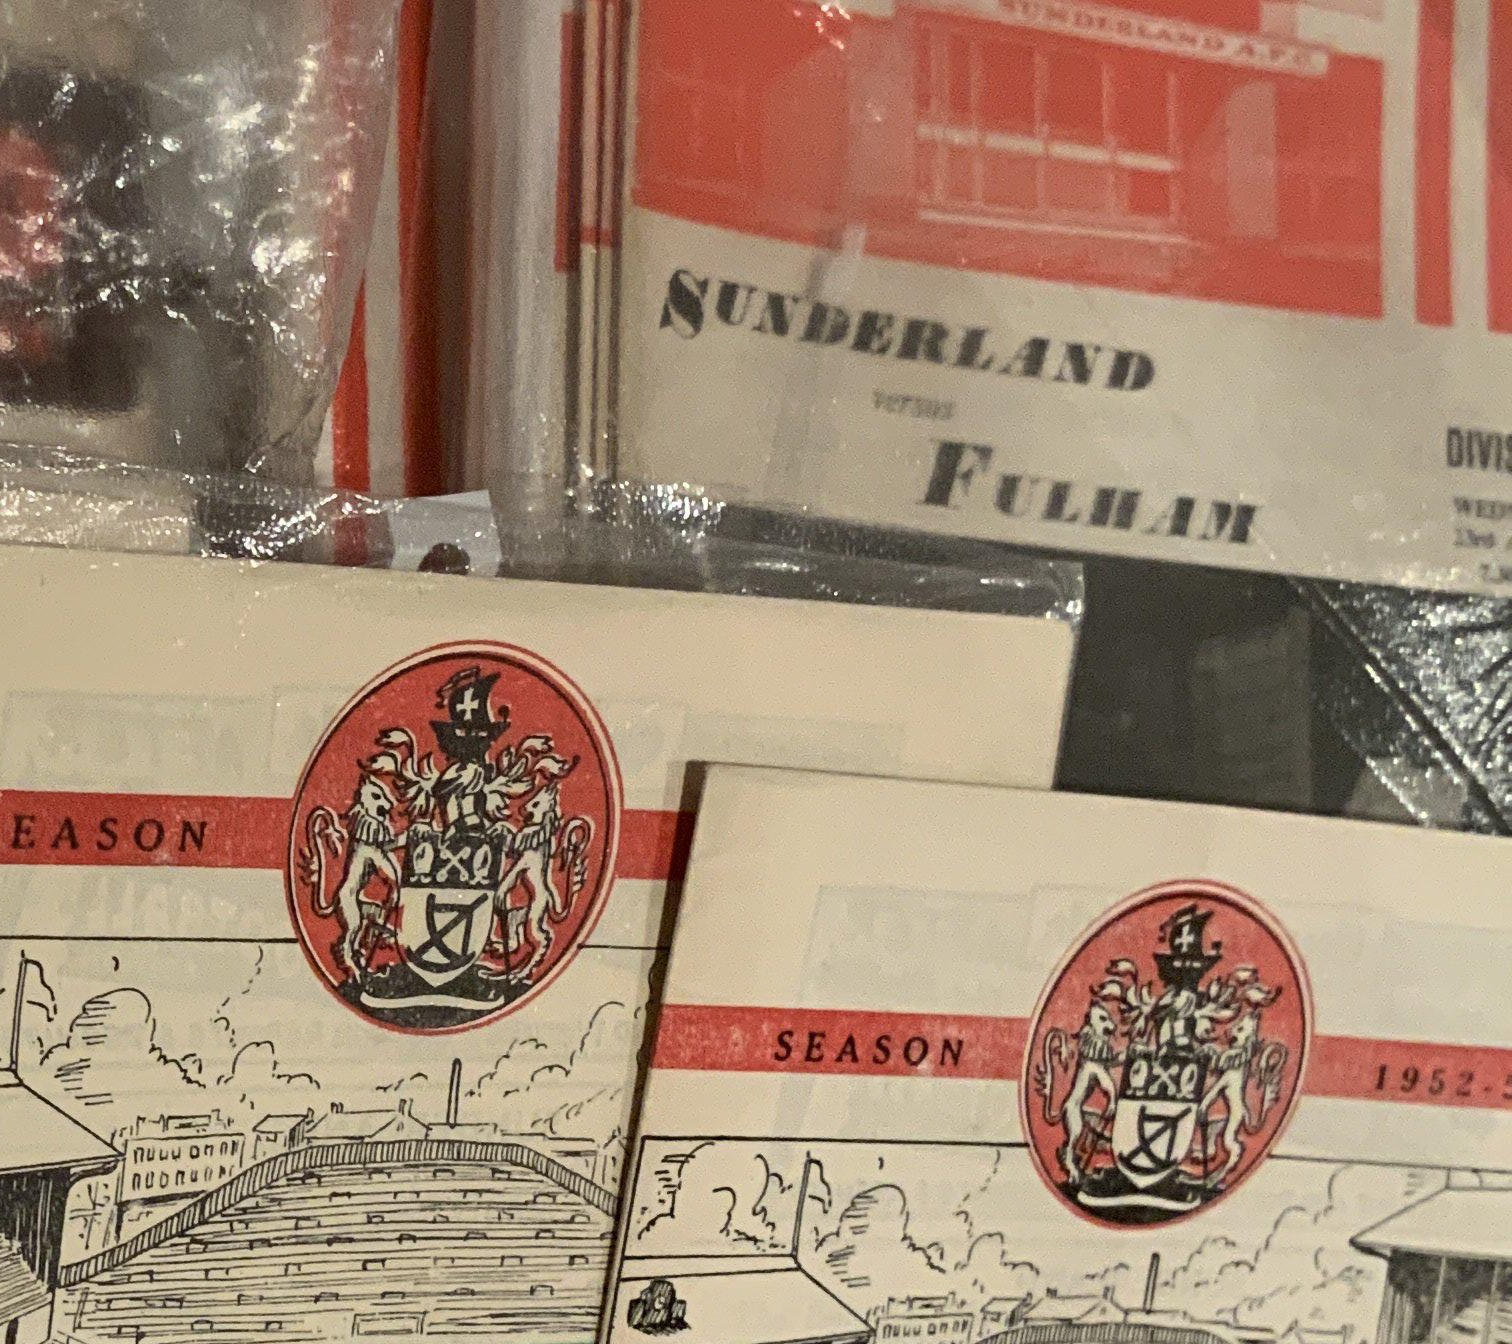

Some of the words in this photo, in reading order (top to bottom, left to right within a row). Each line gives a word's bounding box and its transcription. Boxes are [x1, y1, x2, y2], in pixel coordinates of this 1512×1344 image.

[660, 268, 1157, 392] SUNDERLAND
[917, 438, 1259, 544] FULHAM
[773, 1029, 968, 1068] SEASON
